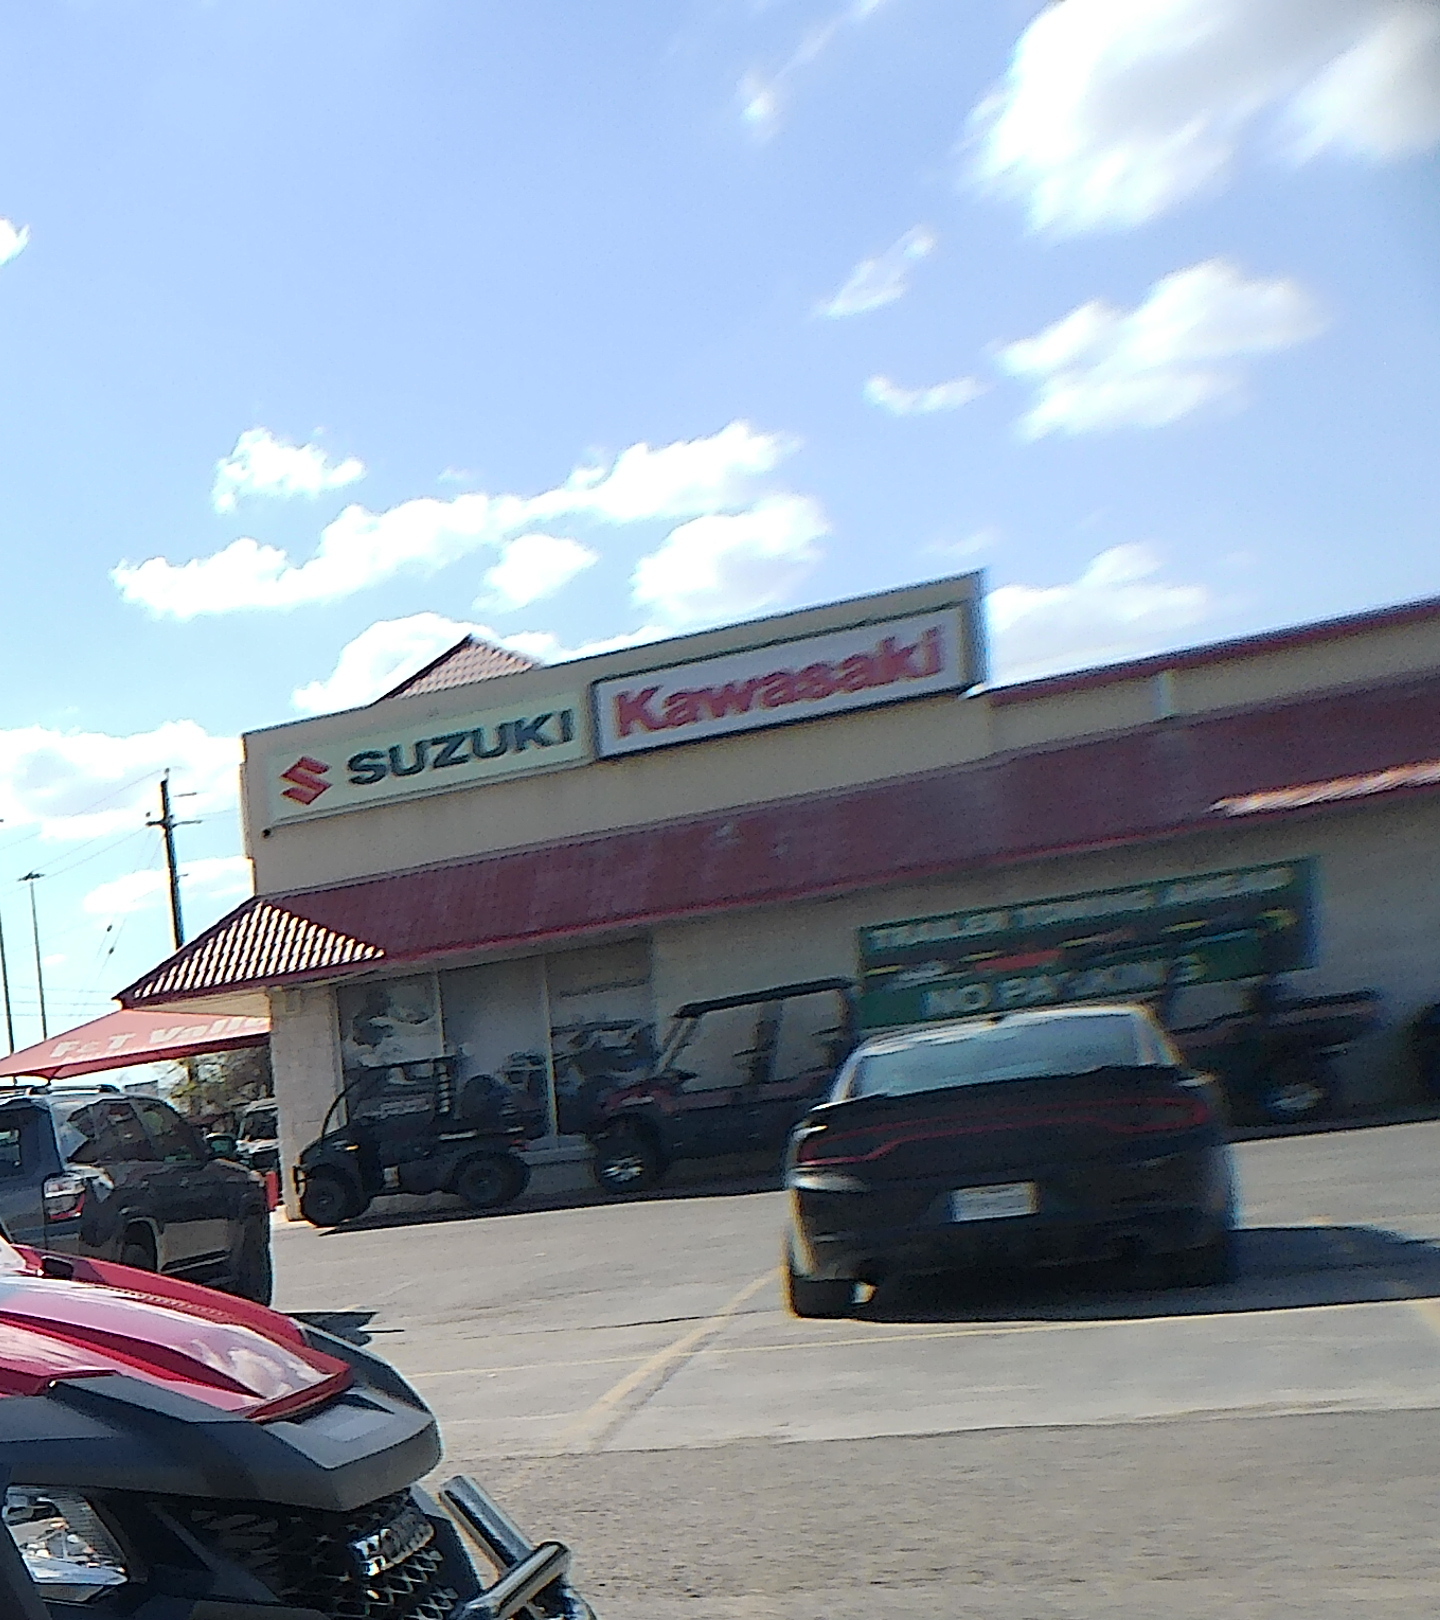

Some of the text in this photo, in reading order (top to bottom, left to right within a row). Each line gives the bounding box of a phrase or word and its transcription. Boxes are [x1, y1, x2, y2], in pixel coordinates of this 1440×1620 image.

[613, 624, 946, 738] Kawasaki
[347, 708, 574, 784] SUZUKI
[149, 1016, 270, 1044] Valle
